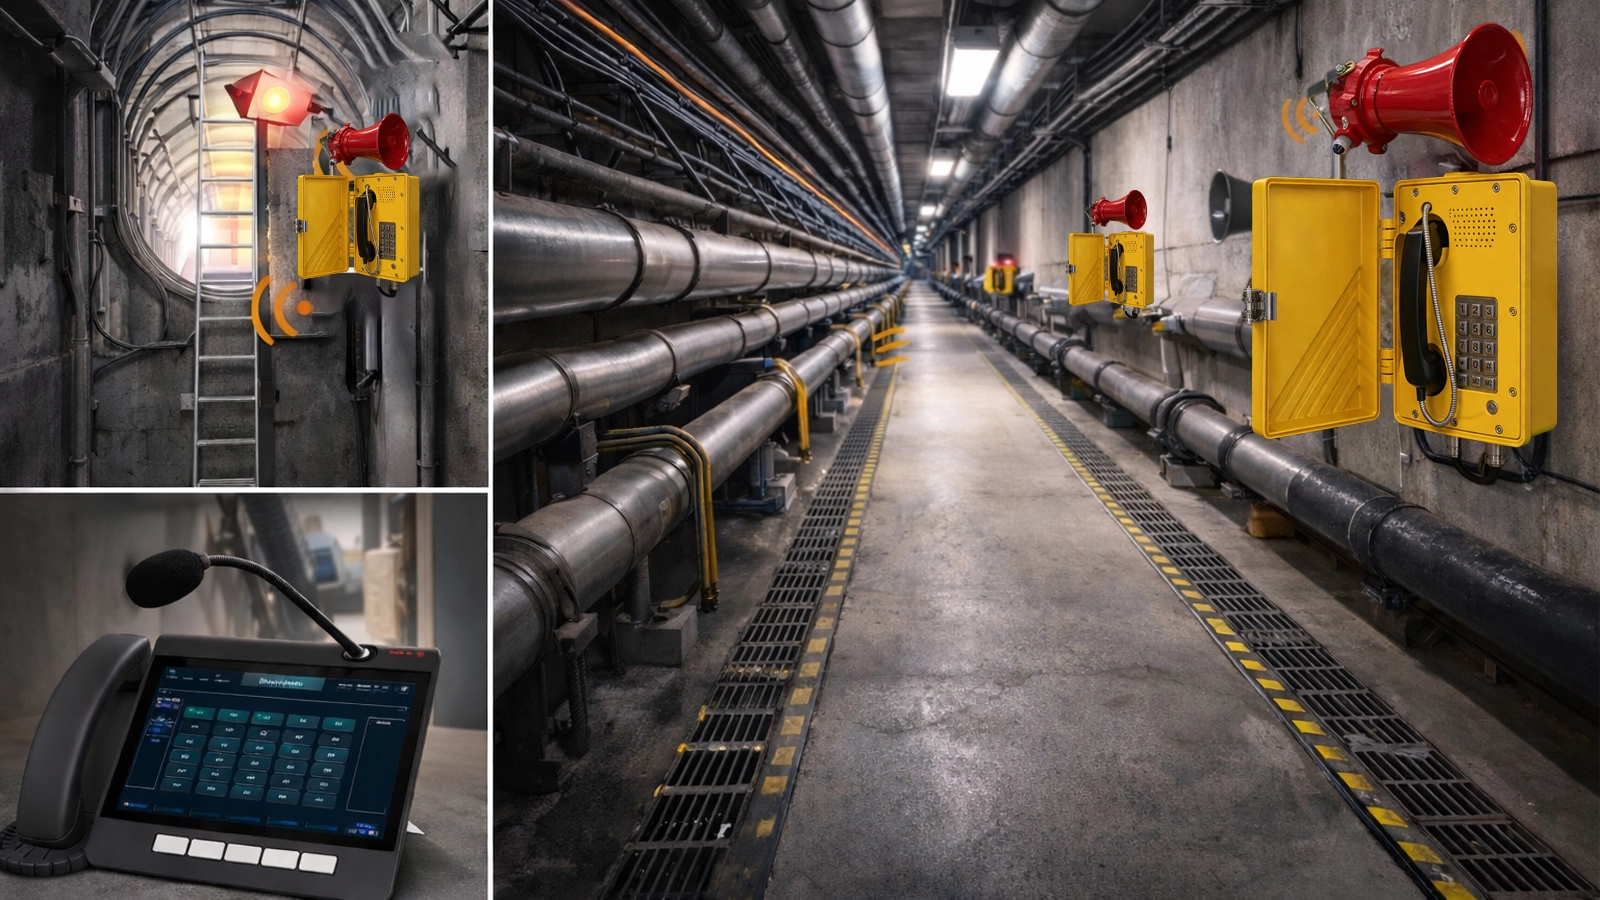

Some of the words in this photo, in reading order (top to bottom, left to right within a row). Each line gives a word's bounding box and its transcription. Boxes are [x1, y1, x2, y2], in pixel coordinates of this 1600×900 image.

[1472, 306, 1478, 314] 2
[1486, 307, 1492, 315] 3
[1459, 323, 1465, 332] 4
[1472, 324, 1478, 333] 5
[1486, 325, 1492, 334] 6
[1459, 341, 1465, 350] 7
[1472, 342, 1478, 351] 8
[1486, 343, 1492, 352] 9
[1472, 360, 1478, 369] 0
